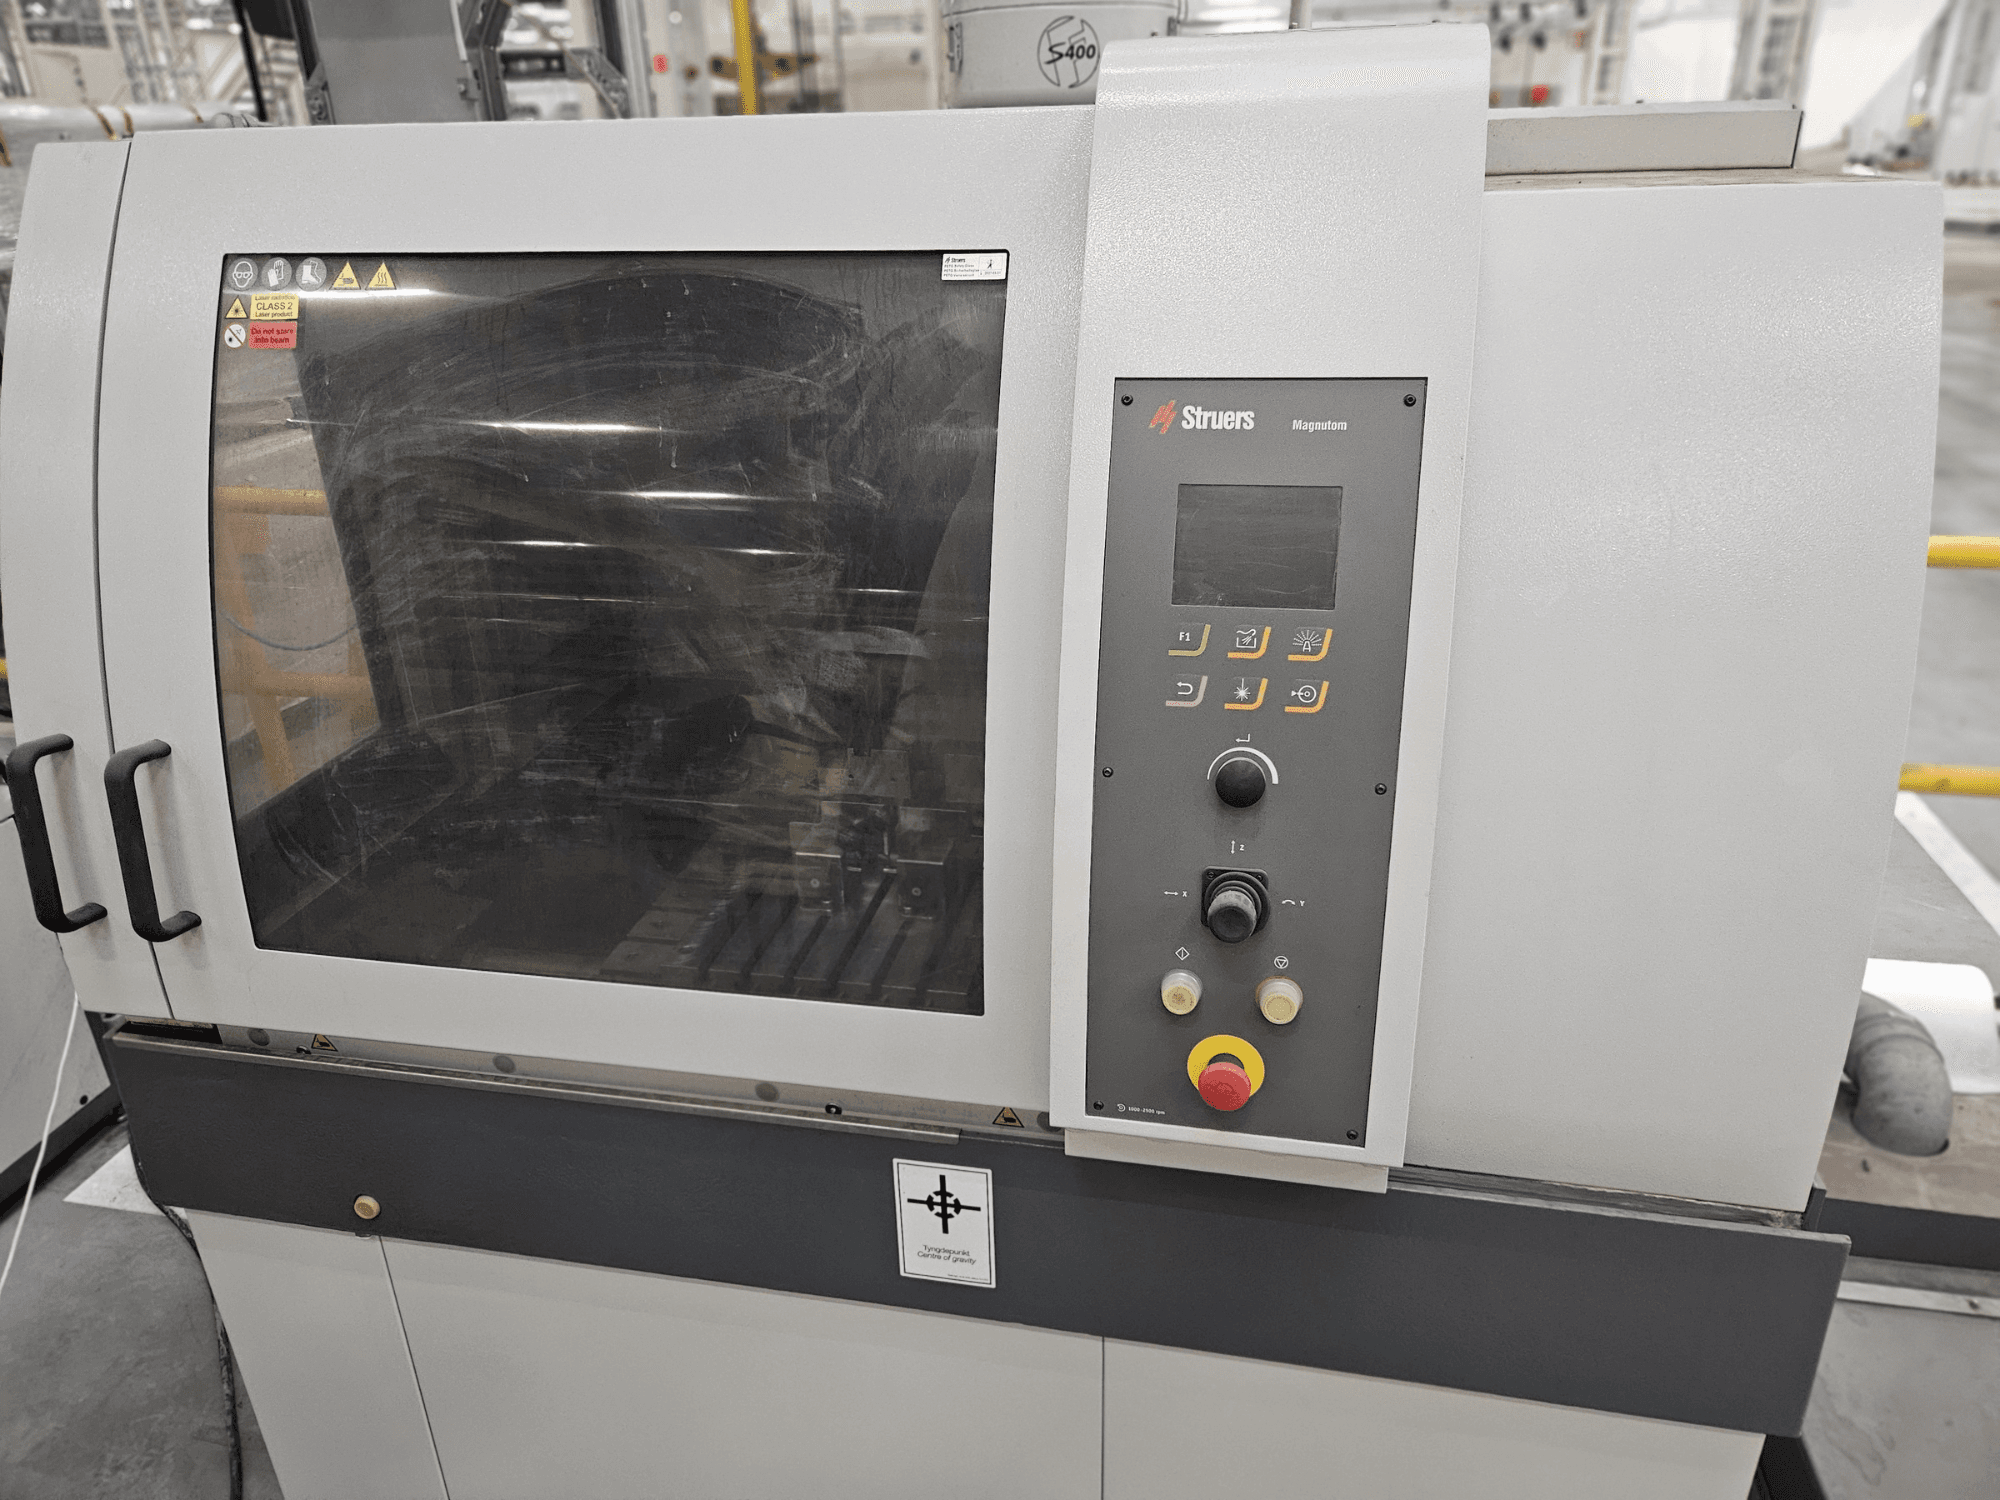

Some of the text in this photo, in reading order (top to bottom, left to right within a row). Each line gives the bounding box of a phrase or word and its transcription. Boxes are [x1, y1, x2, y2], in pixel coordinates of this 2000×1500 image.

[1044, 41, 1096, 64] S400
[256, 302, 293, 310] CLASS 2
[1181, 405, 1255, 430] Struers
[1292, 419, 1347, 433] Magnutom
[1179, 632, 1191, 642] F1
[923, 1244, 970, 1257] Tyngdepunkt
[917, 1251, 942, 1260] Centre
[952, 1256, 977, 1265] gravity
